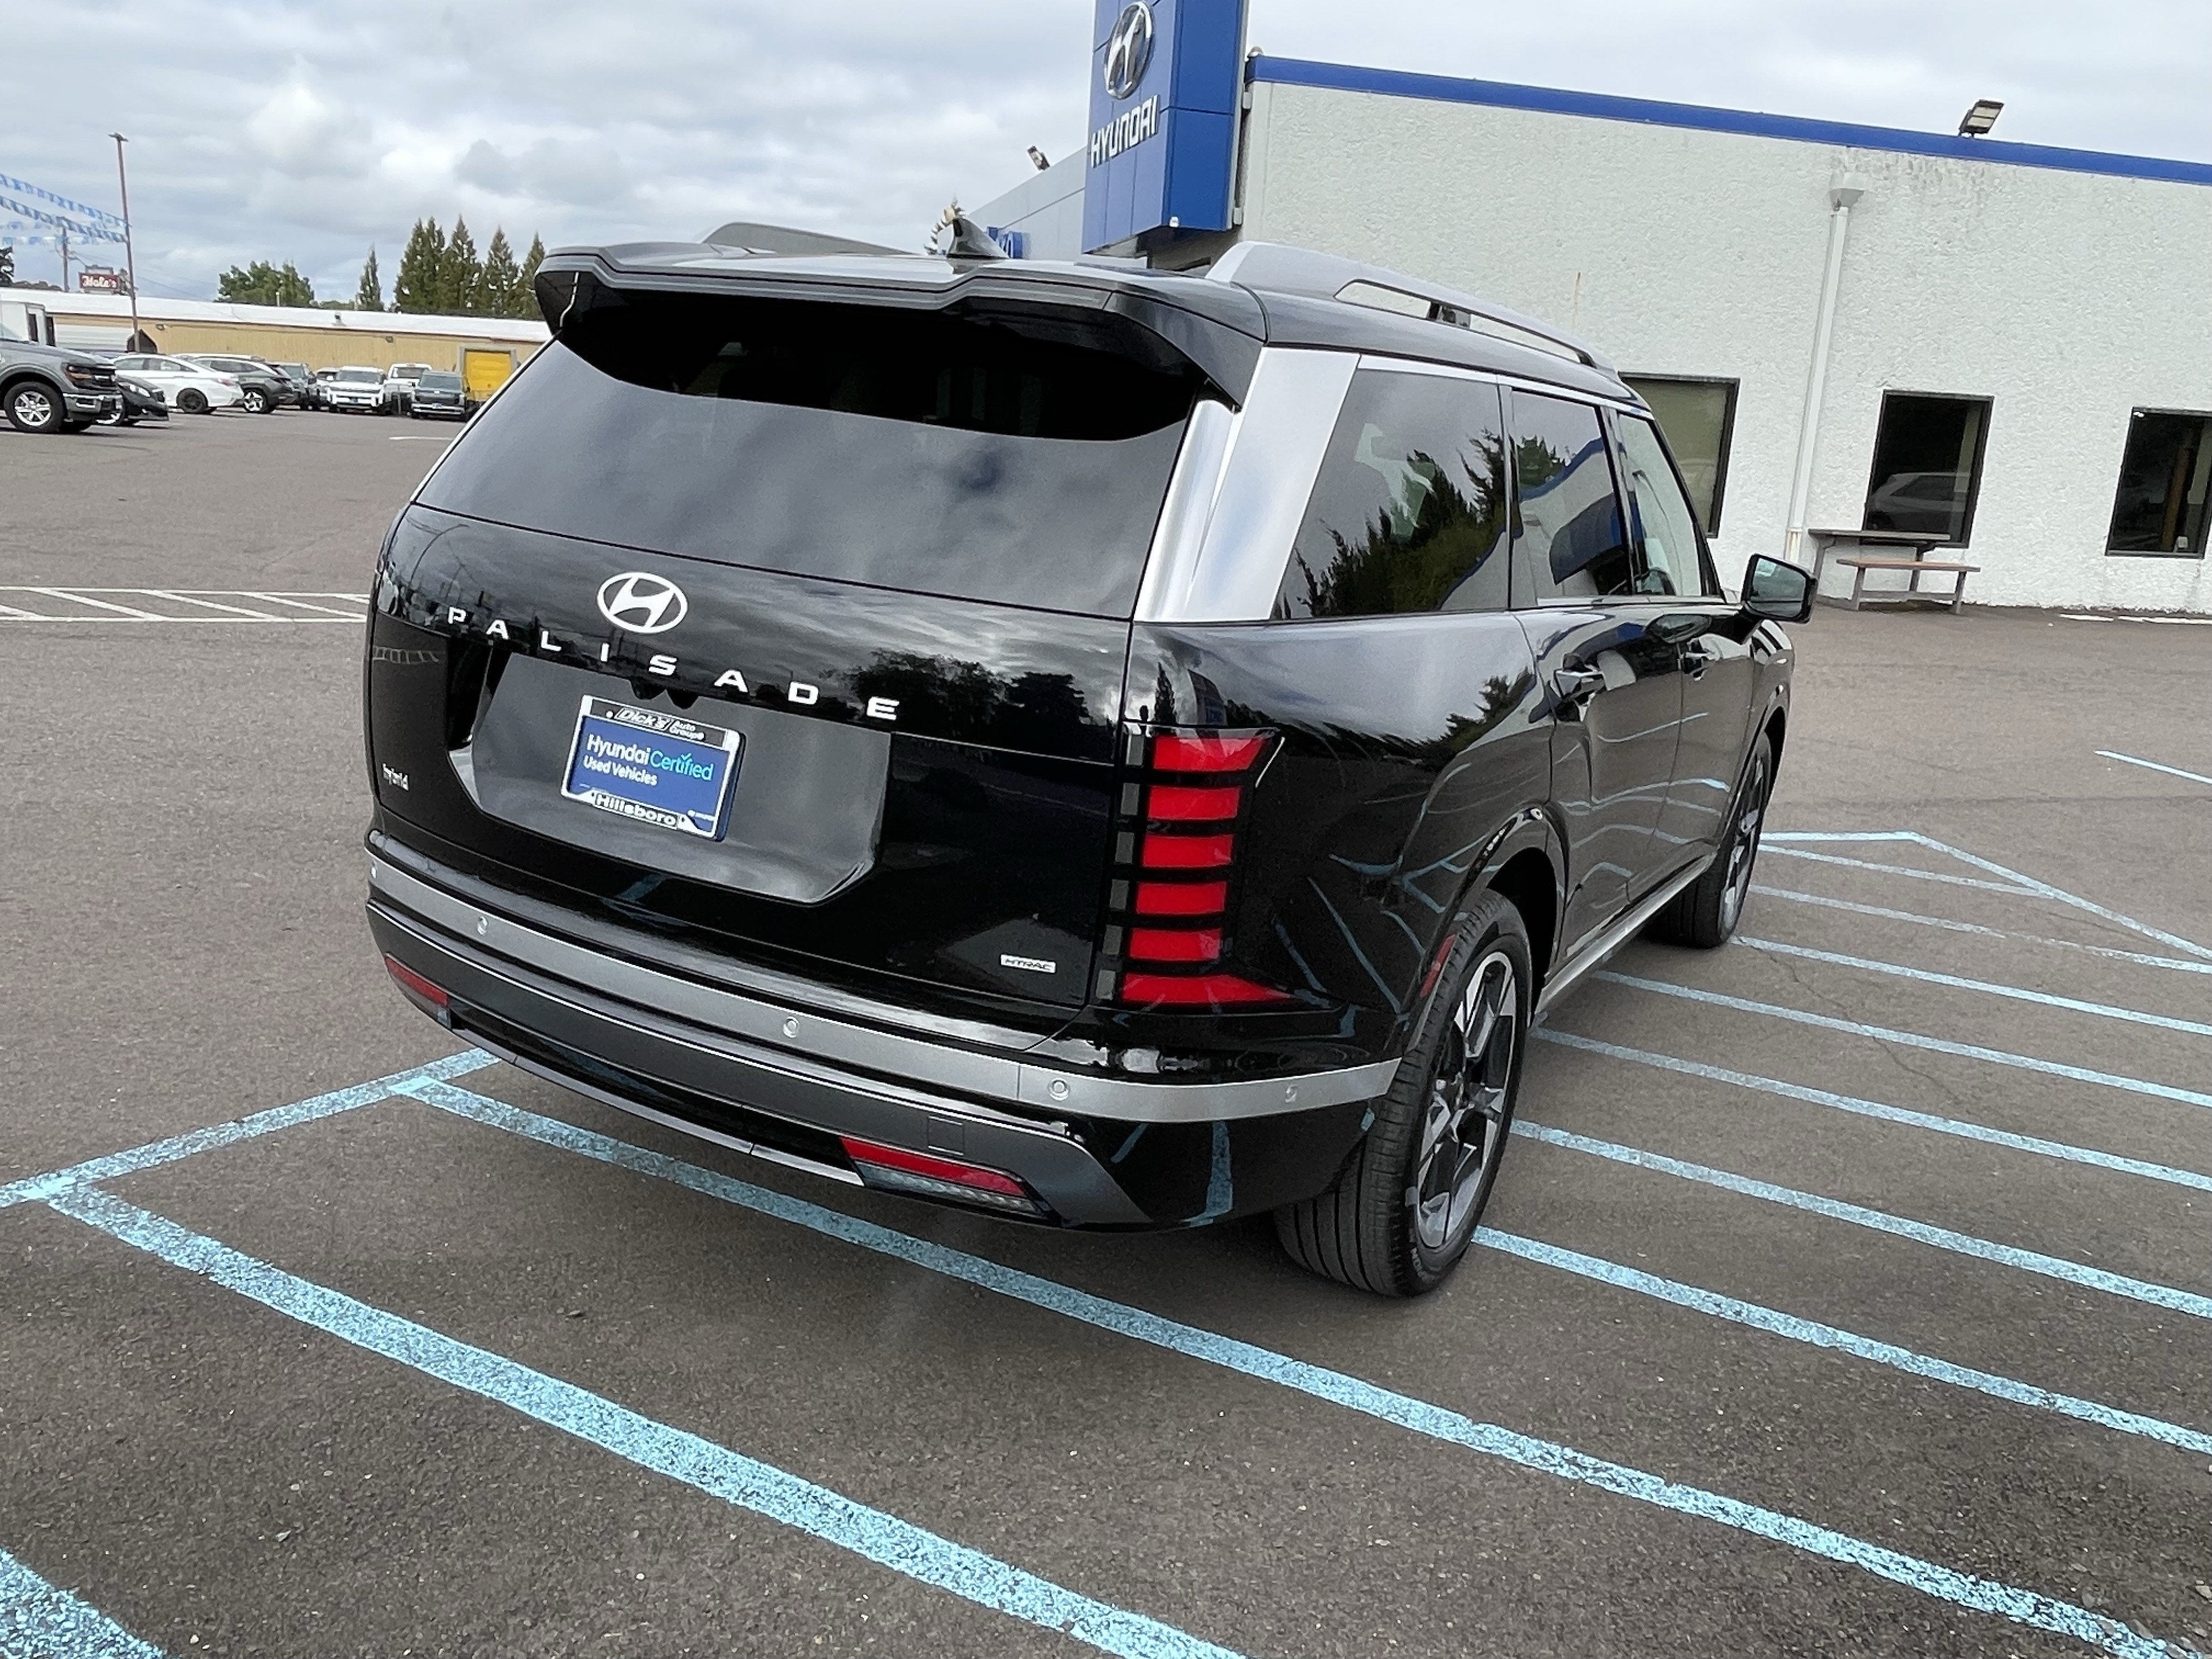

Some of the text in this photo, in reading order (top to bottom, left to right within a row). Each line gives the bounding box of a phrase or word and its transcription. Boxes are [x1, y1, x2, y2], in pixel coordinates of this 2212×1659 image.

[1091, 94, 1159, 168] HYUNDAI
[448, 607, 900, 721] PALISADE
[583, 754, 658, 786] Used Vehicles
[596, 793, 676, 826] Hillsboro
